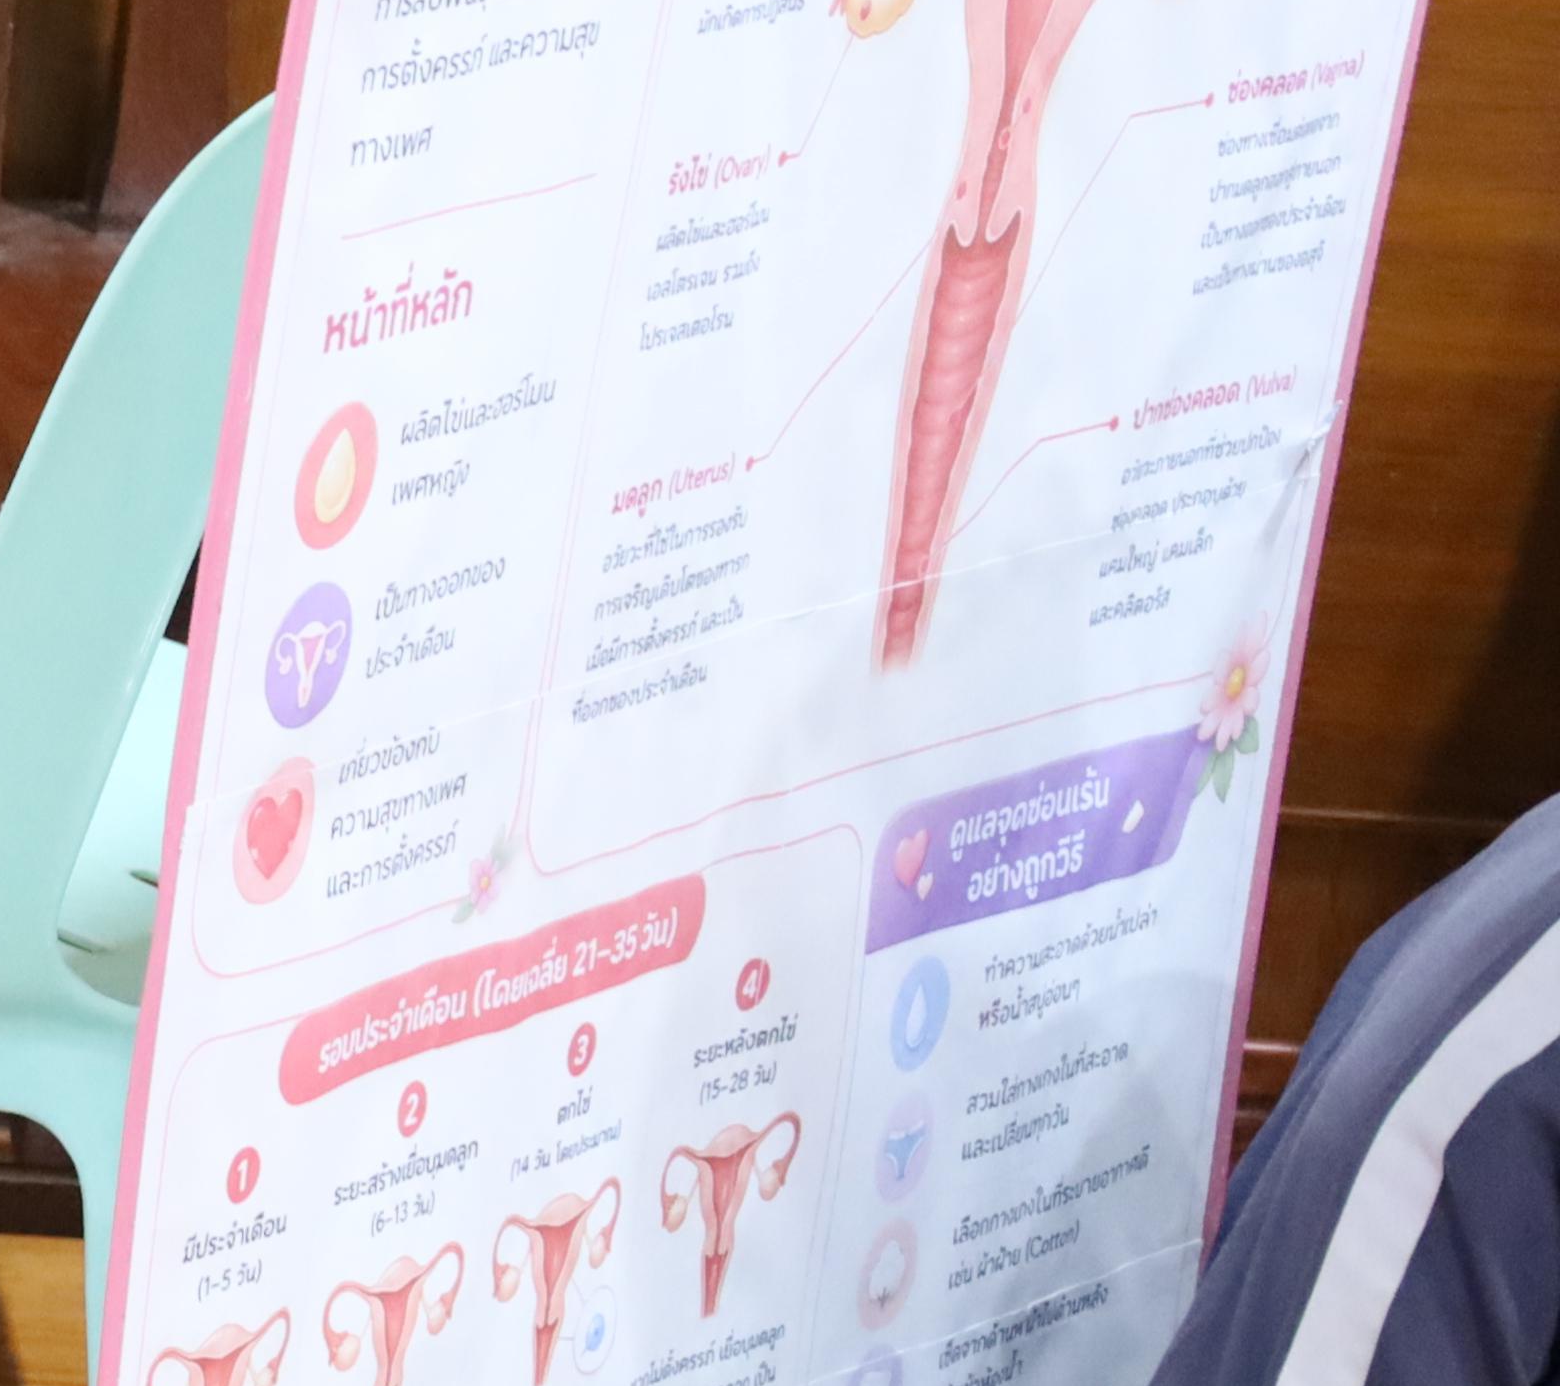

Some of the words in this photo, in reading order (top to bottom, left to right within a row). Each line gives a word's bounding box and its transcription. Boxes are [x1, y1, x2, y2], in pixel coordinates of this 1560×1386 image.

[322, 263, 474, 354] หน้าที่หลัก
